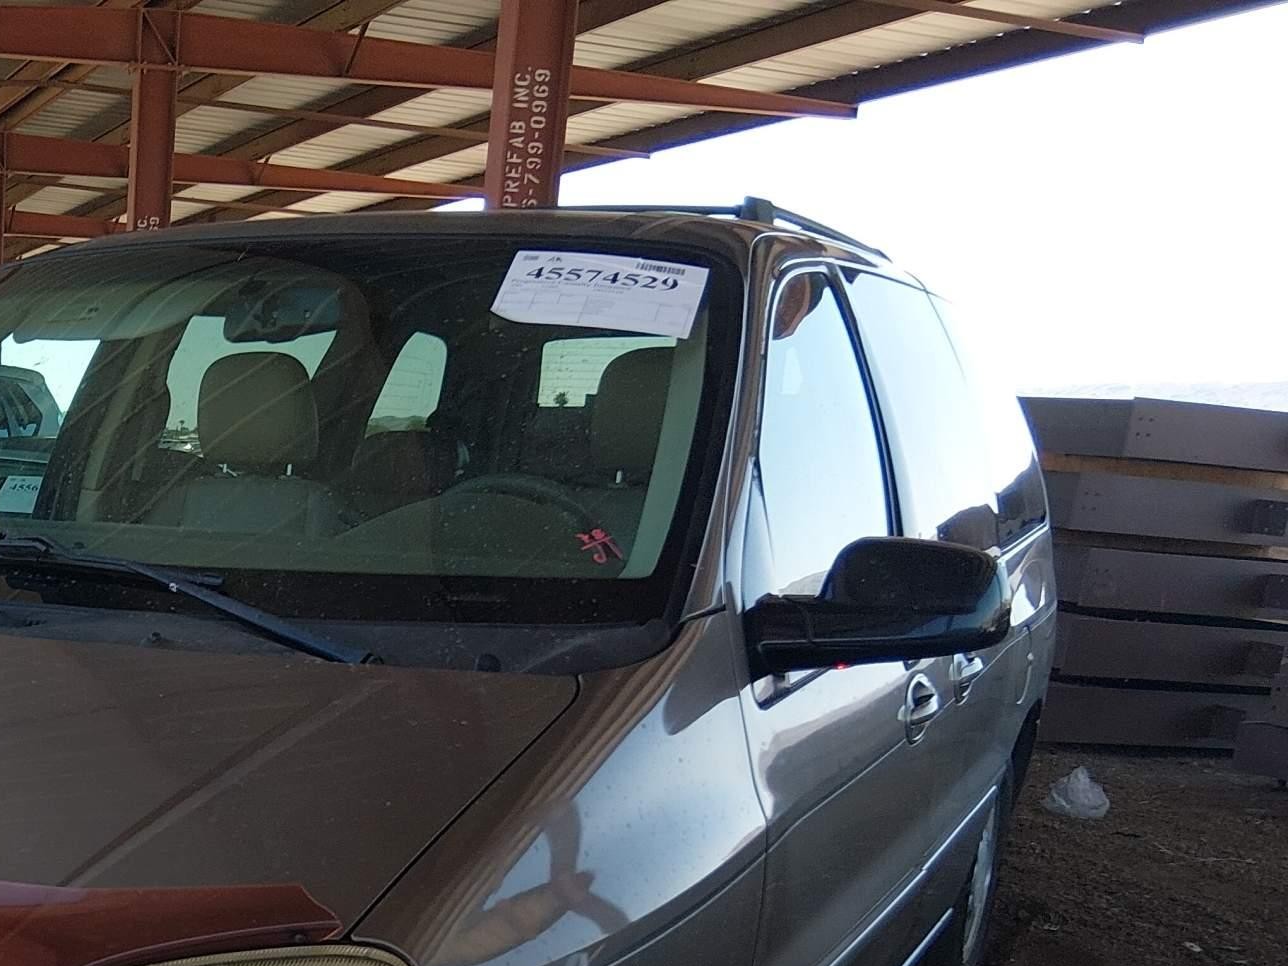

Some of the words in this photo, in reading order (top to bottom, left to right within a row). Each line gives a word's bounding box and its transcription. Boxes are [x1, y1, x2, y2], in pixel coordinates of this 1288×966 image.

[511, 66, 532, 109] INC.
[502, 120, 527, 208] PREFAB
[525, 265, 679, 292] 45574529
